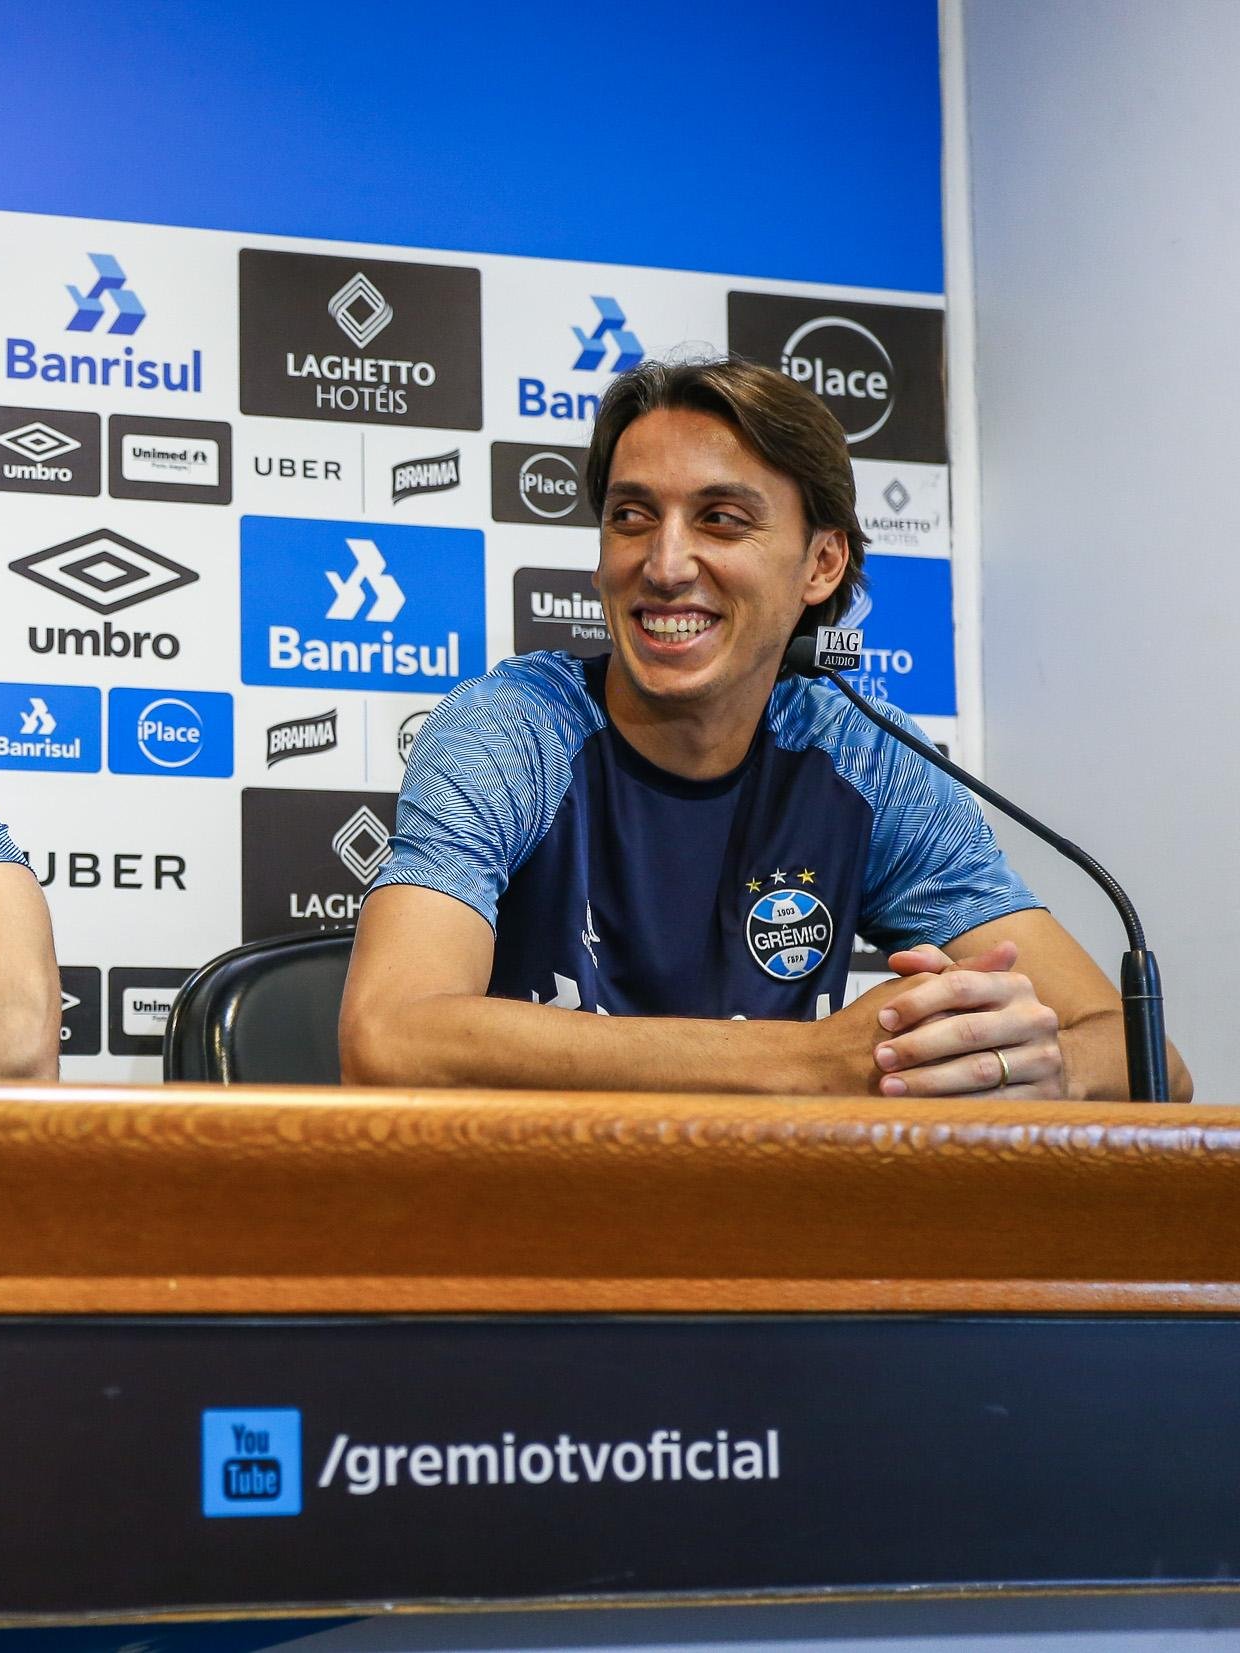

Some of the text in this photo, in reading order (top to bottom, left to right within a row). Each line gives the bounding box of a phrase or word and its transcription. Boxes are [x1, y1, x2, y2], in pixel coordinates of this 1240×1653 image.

[6, 337, 202, 393] Banrisul
[286, 352, 436, 387] LAGHETTO
[316, 384, 408, 414] HOTÉIS
[132, 447, 187, 461] Unimed
[254, 456, 341, 480] UBER
[3, 463, 73, 482] umbro
[395, 459, 457, 491] BRAHMA
[519, 471, 577, 496] iPlace
[28, 621, 180, 660] umbro
[269, 625, 459, 678] Banrisul
[824, 630, 859, 652] TAG
[824, 655, 855, 667] AUDIO
[137, 720, 200, 744] iPlace
[270, 720, 335, 753] BRAHMA
[776, 907, 796, 917] 1903
[753, 924, 828, 951] GRÊMIO
[786, 954, 805, 964] FBPA
[231, 1423, 270, 1455] You
[318, 1429, 780, 1495] /gremiotvoficial
[228, 1463, 278, 1495] Tube
